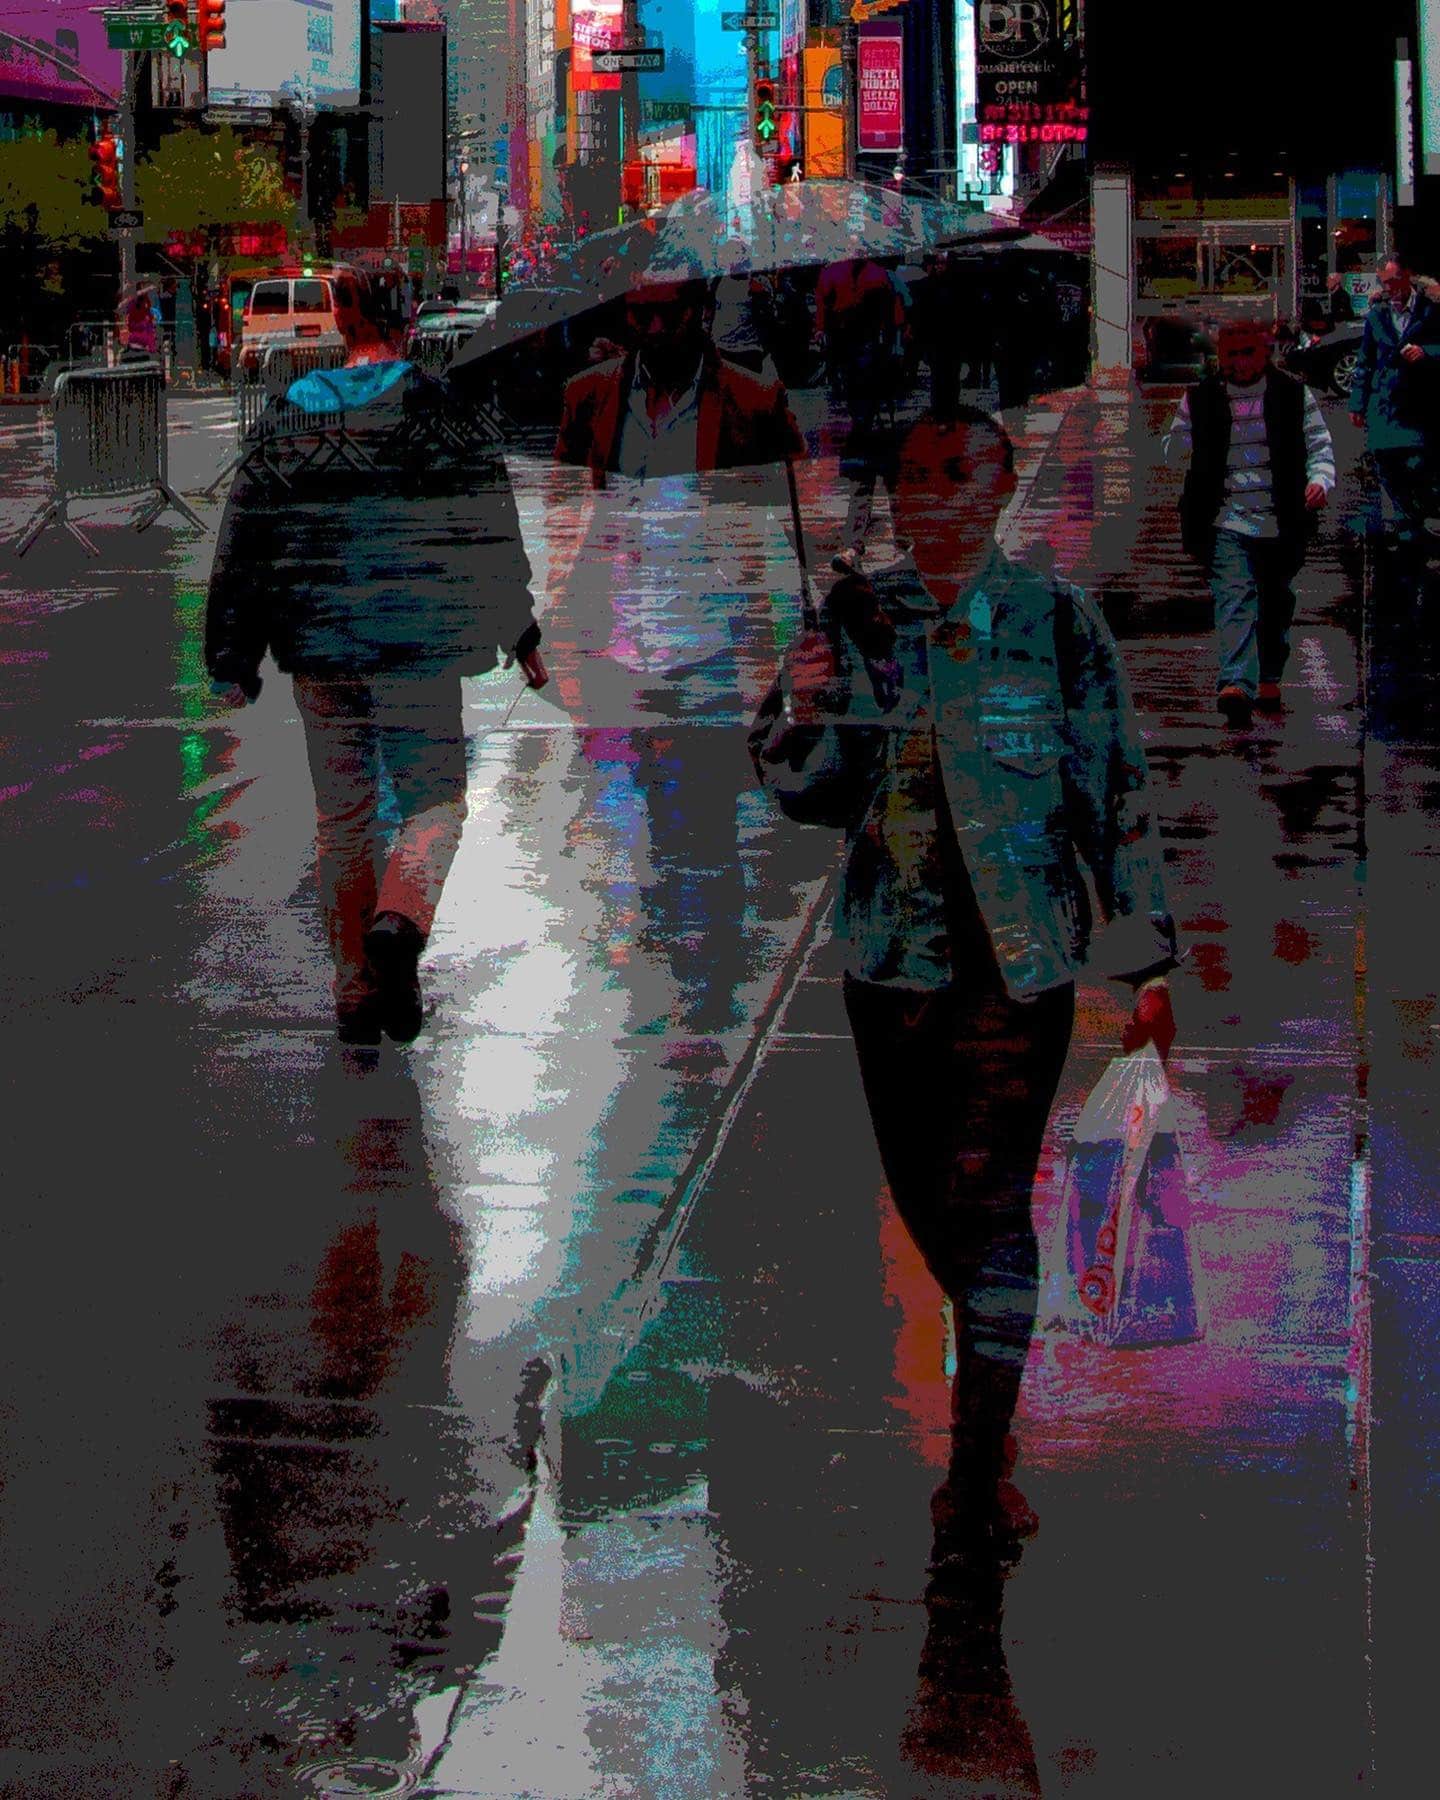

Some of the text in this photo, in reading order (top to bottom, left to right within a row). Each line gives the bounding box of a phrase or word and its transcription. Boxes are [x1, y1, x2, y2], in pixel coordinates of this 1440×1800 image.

[130, 29, 143, 43] W
[574, 22, 611, 40] STELLA
[572, 32, 610, 49] ARTOIS
[602, 54, 654, 66] ONE WAY
[862, 69, 897, 78] BETTE
[860, 79, 899, 89] MIDLER
[994, 80, 1037, 95] OPEN
[862, 101, 897, 112] DOLLY!
